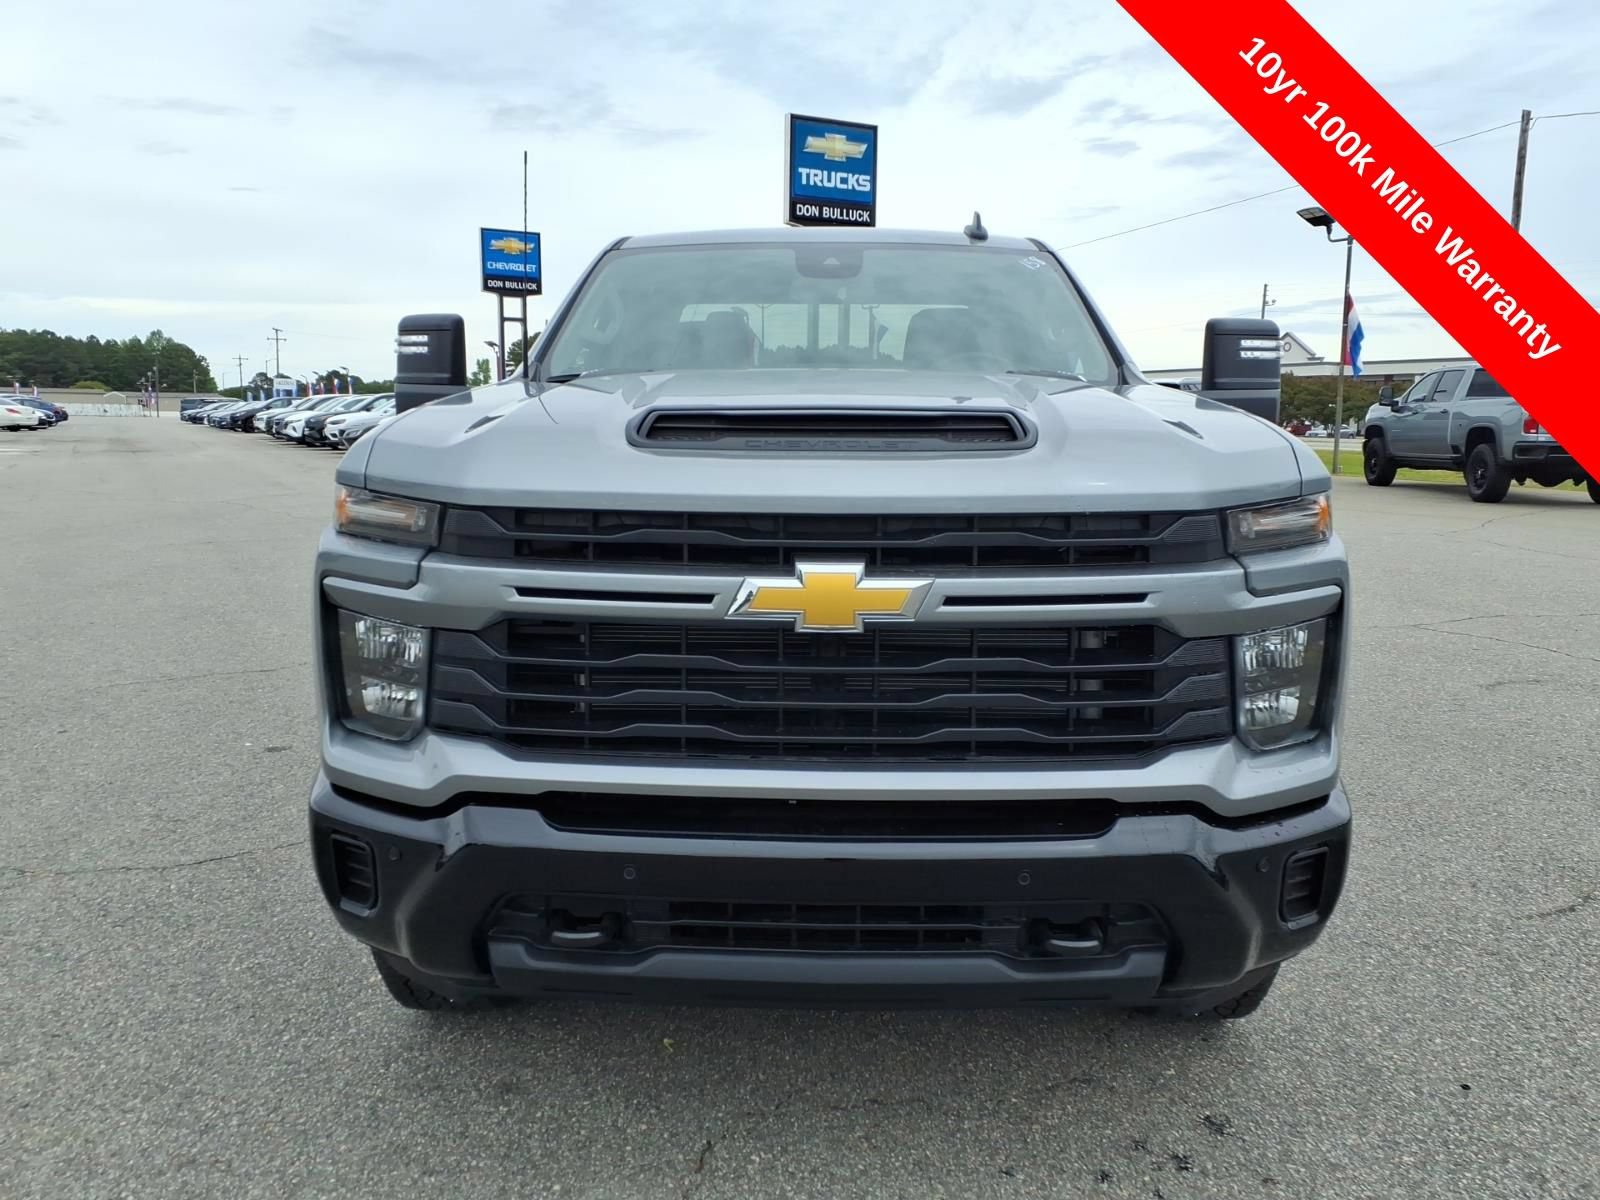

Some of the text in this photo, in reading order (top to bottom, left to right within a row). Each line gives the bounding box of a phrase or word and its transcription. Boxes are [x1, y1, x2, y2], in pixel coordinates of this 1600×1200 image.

[798, 167, 871, 192] TRUCKS
[796, 204, 871, 223] DON BULLUCK
[487, 261, 536, 273] CHEVROLET
[487, 279, 503, 288] DON
[744, 439, 919, 449] CHEVROLET
